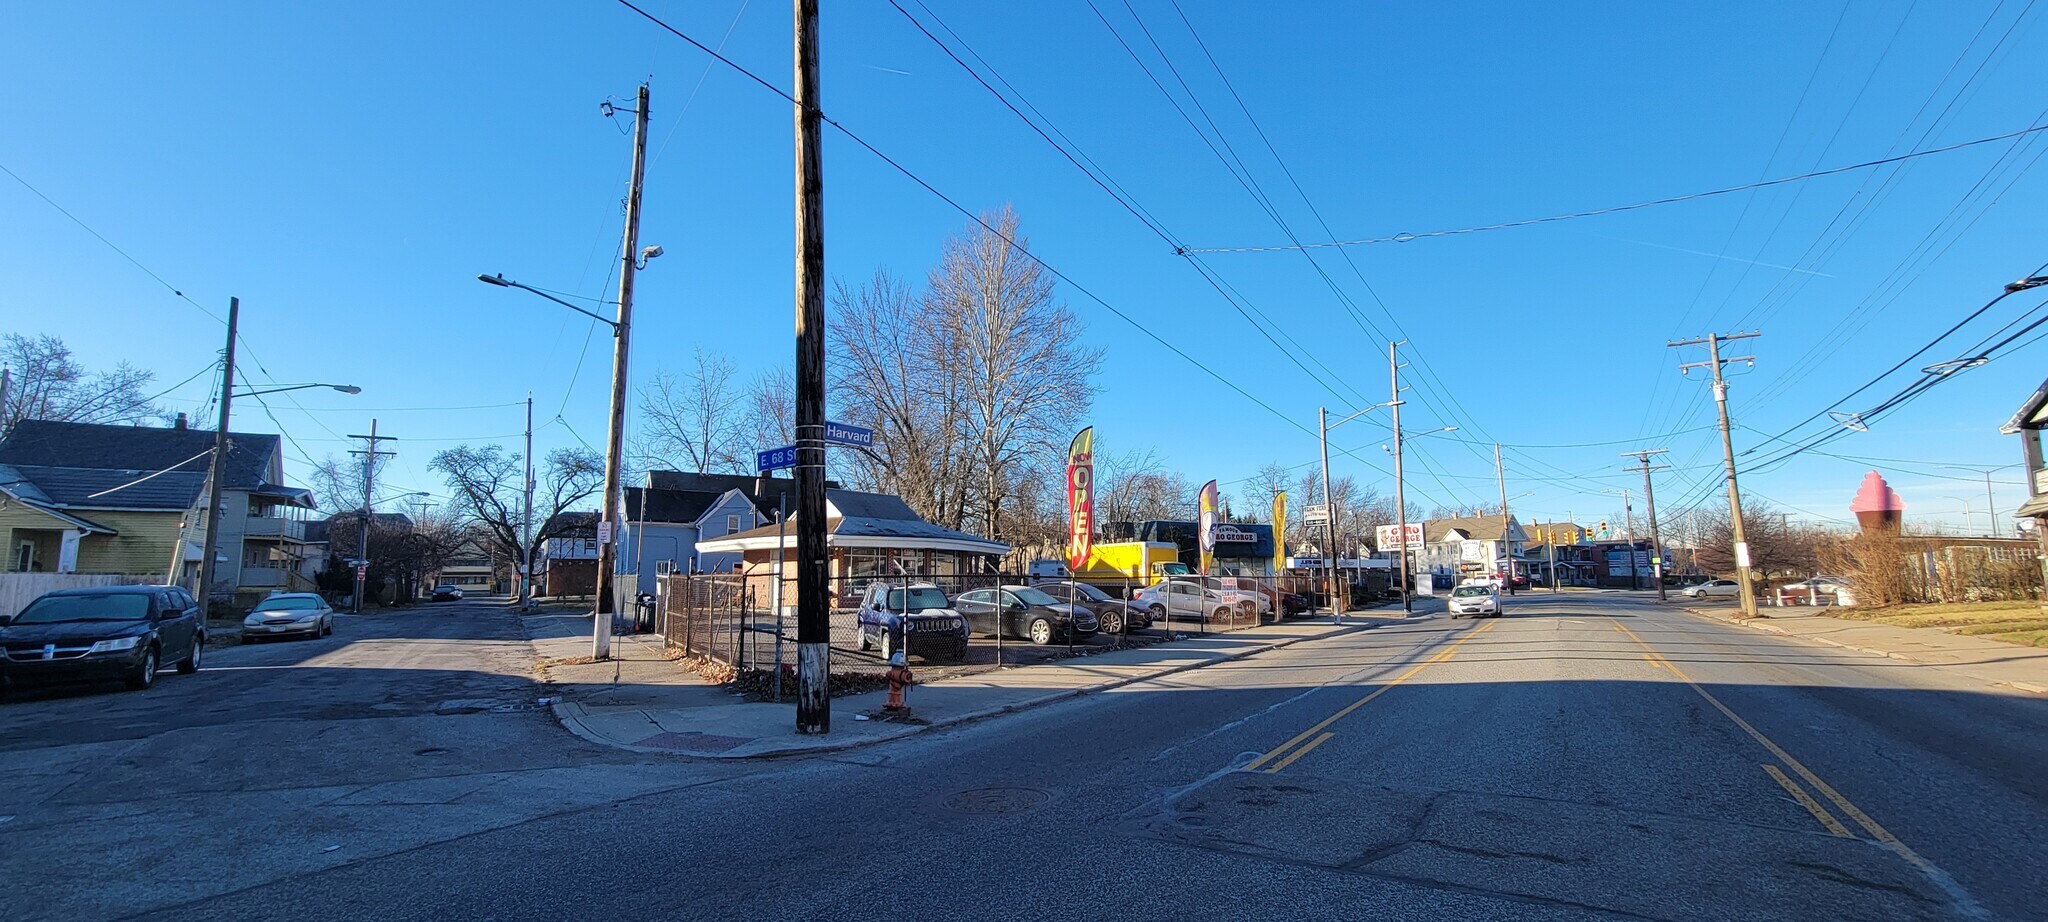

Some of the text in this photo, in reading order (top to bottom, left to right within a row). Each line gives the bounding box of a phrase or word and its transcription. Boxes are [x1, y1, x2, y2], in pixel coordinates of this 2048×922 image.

[827, 424, 871, 443] Harvard
[761, 455, 769, 467] E.
[771, 451, 784, 464] 68
[1073, 450, 1092, 464] NOW
[1073, 467, 1090, 557] OPEN
[1226, 533, 1253, 541] GEORGE
[1391, 526, 1420, 536] GRO
[1390, 534, 1421, 543] GERGE
